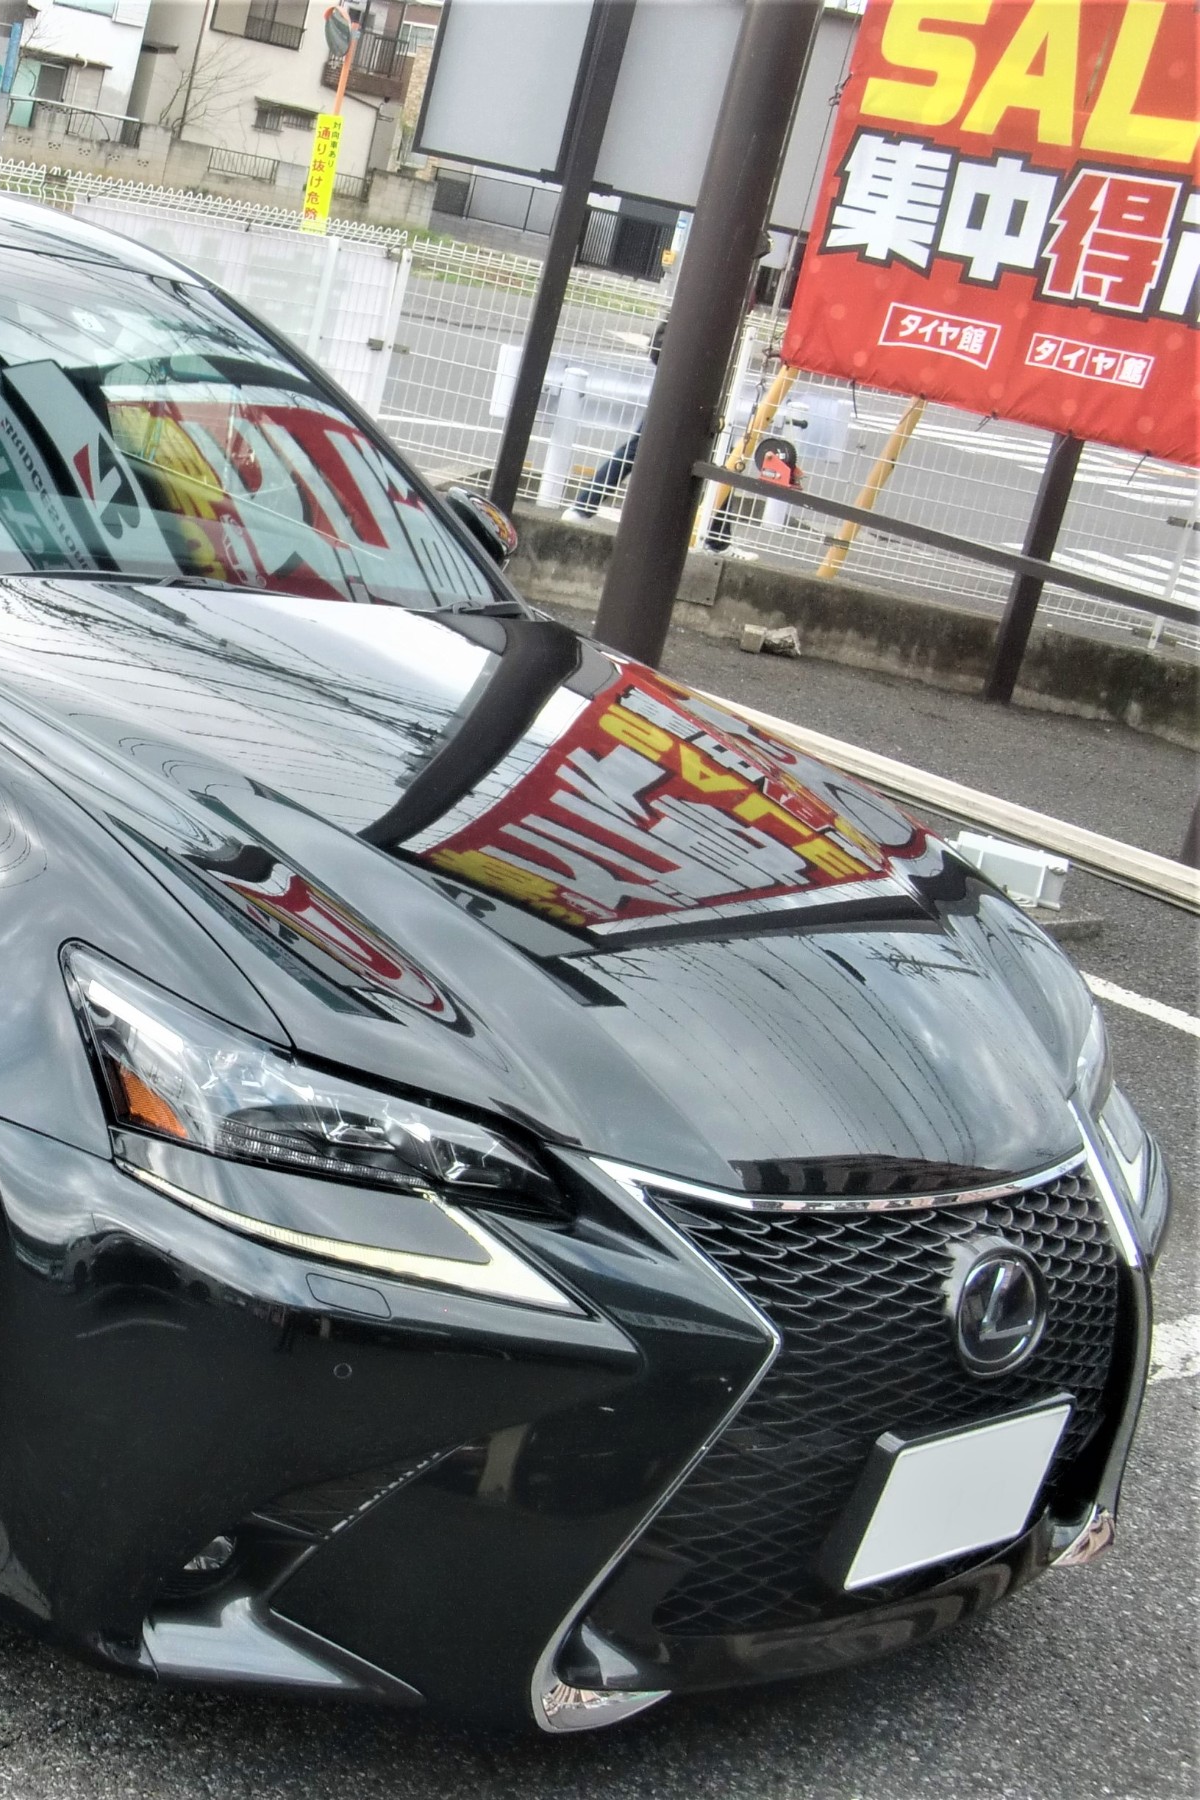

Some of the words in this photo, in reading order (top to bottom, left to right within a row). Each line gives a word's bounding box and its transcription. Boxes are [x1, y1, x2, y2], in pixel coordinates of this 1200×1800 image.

[327, 121, 342, 168] 対向車あり
[304, 126, 331, 221] 通り抜け危険
[822, 130, 1200, 322] 集中得
[898, 314, 988, 355] タイヤ館
[1034, 338, 1147, 384] タイヤ館
